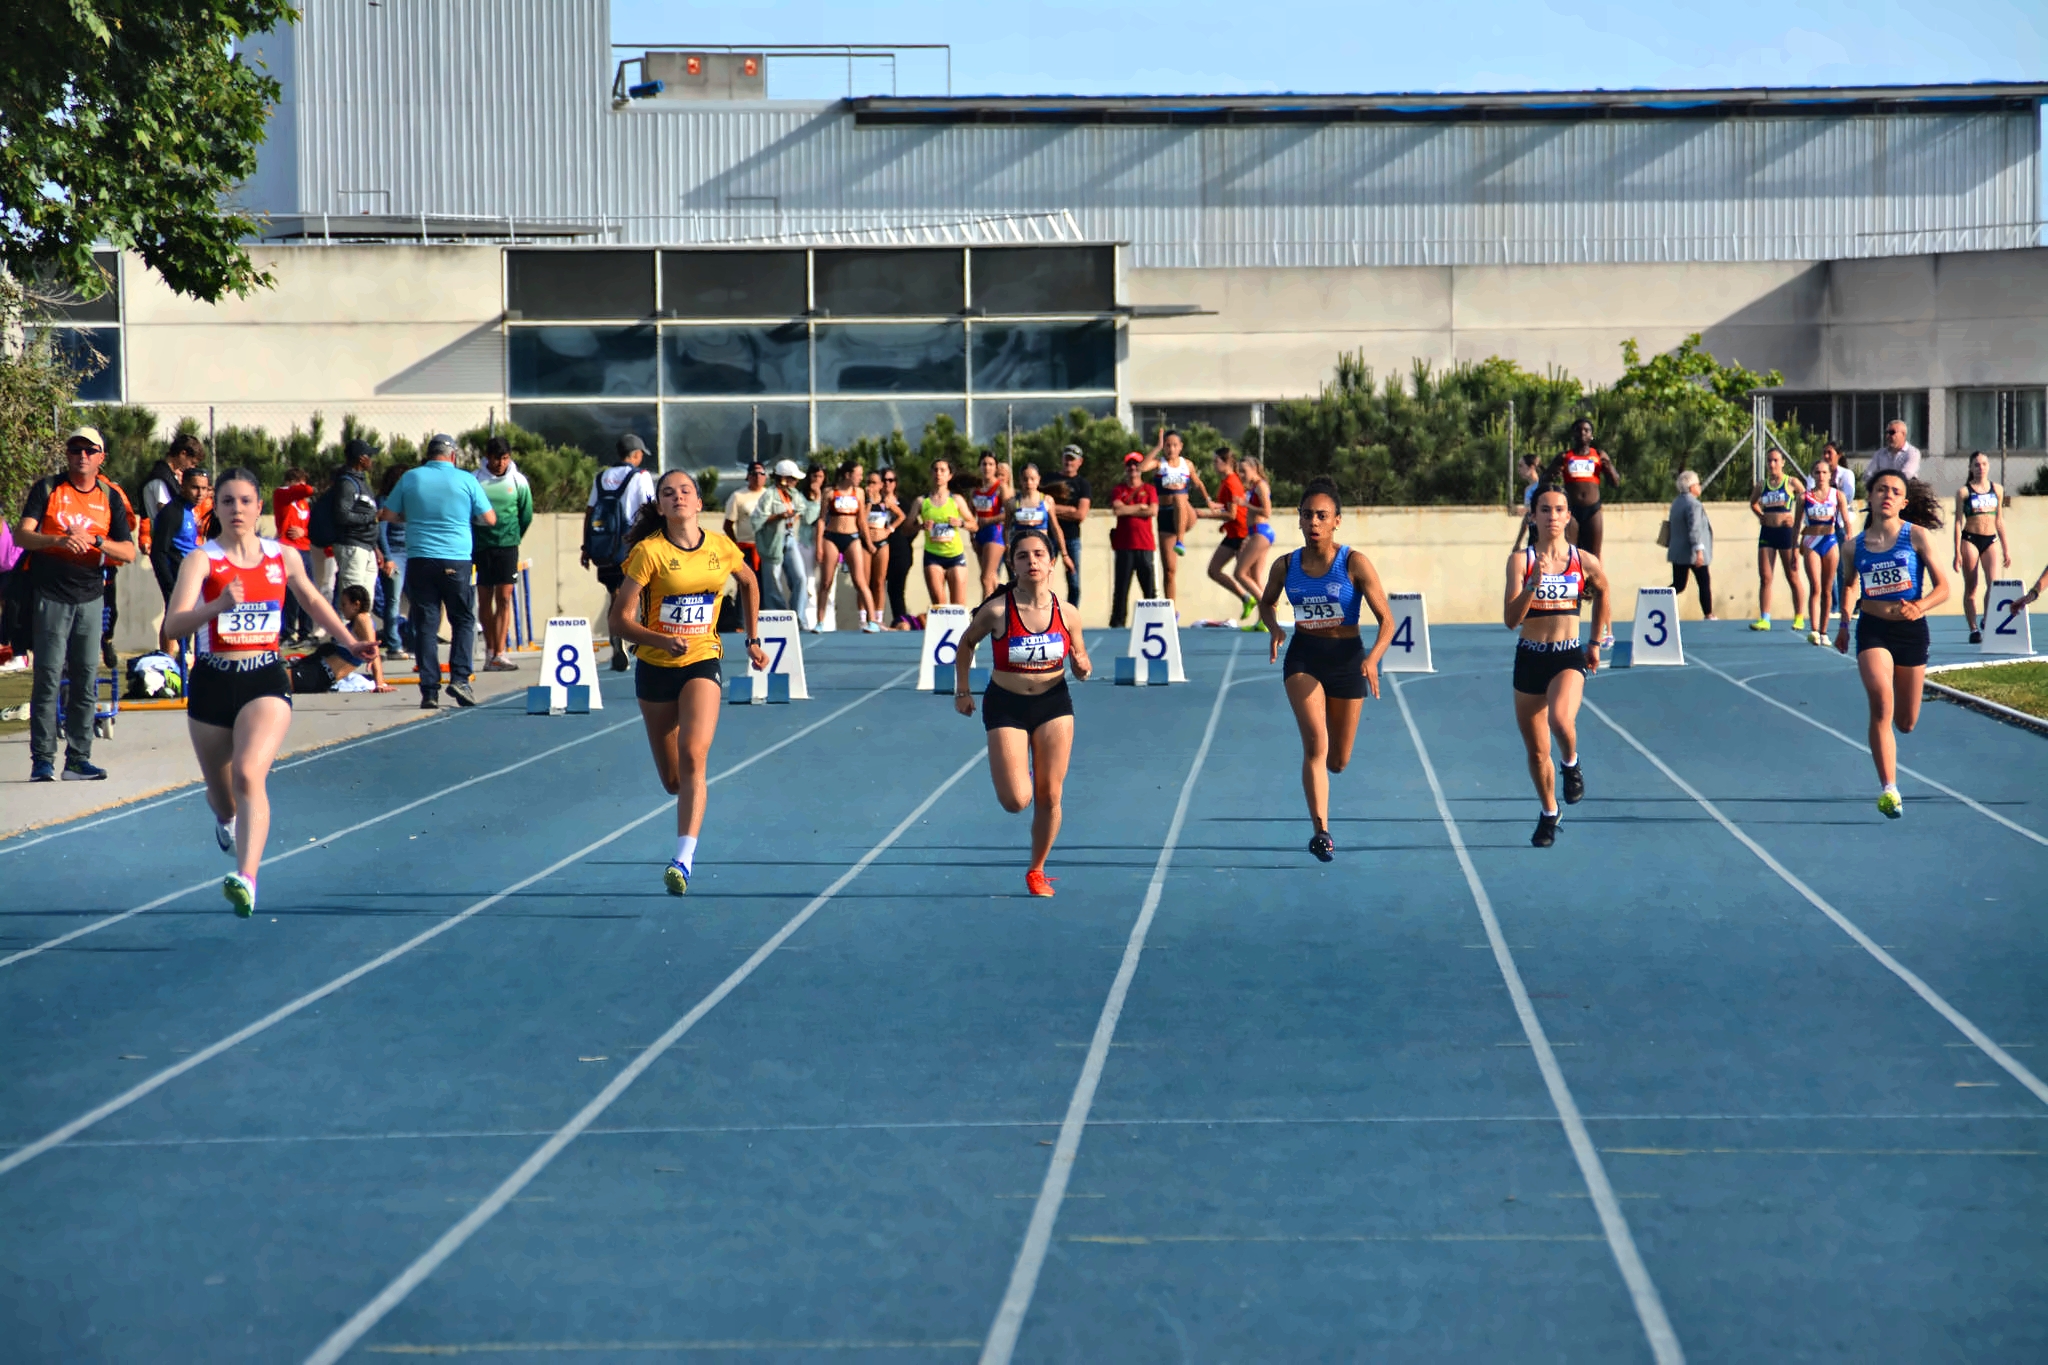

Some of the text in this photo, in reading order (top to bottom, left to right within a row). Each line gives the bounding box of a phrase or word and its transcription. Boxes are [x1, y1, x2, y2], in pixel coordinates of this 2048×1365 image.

[1872, 569, 1902, 585] 488
[1536, 585, 1568, 599] 682
[229, 613, 270, 632] 387
[670, 606, 704, 623] 414
[1303, 604, 1335, 619] 543
[1995, 599, 2017, 634] 2
[1391, 615, 1415, 653] 4
[1644, 609, 1668, 647] 3
[934, 628, 958, 665] 6
[1141, 622, 1167, 660] 5
[1521, 640, 1547, 652] PRO
[236, 650, 275, 672] NIKE
[764, 637, 787, 674] 7
[1024, 645, 1049, 662] 71
[555, 644, 581, 688] 8
